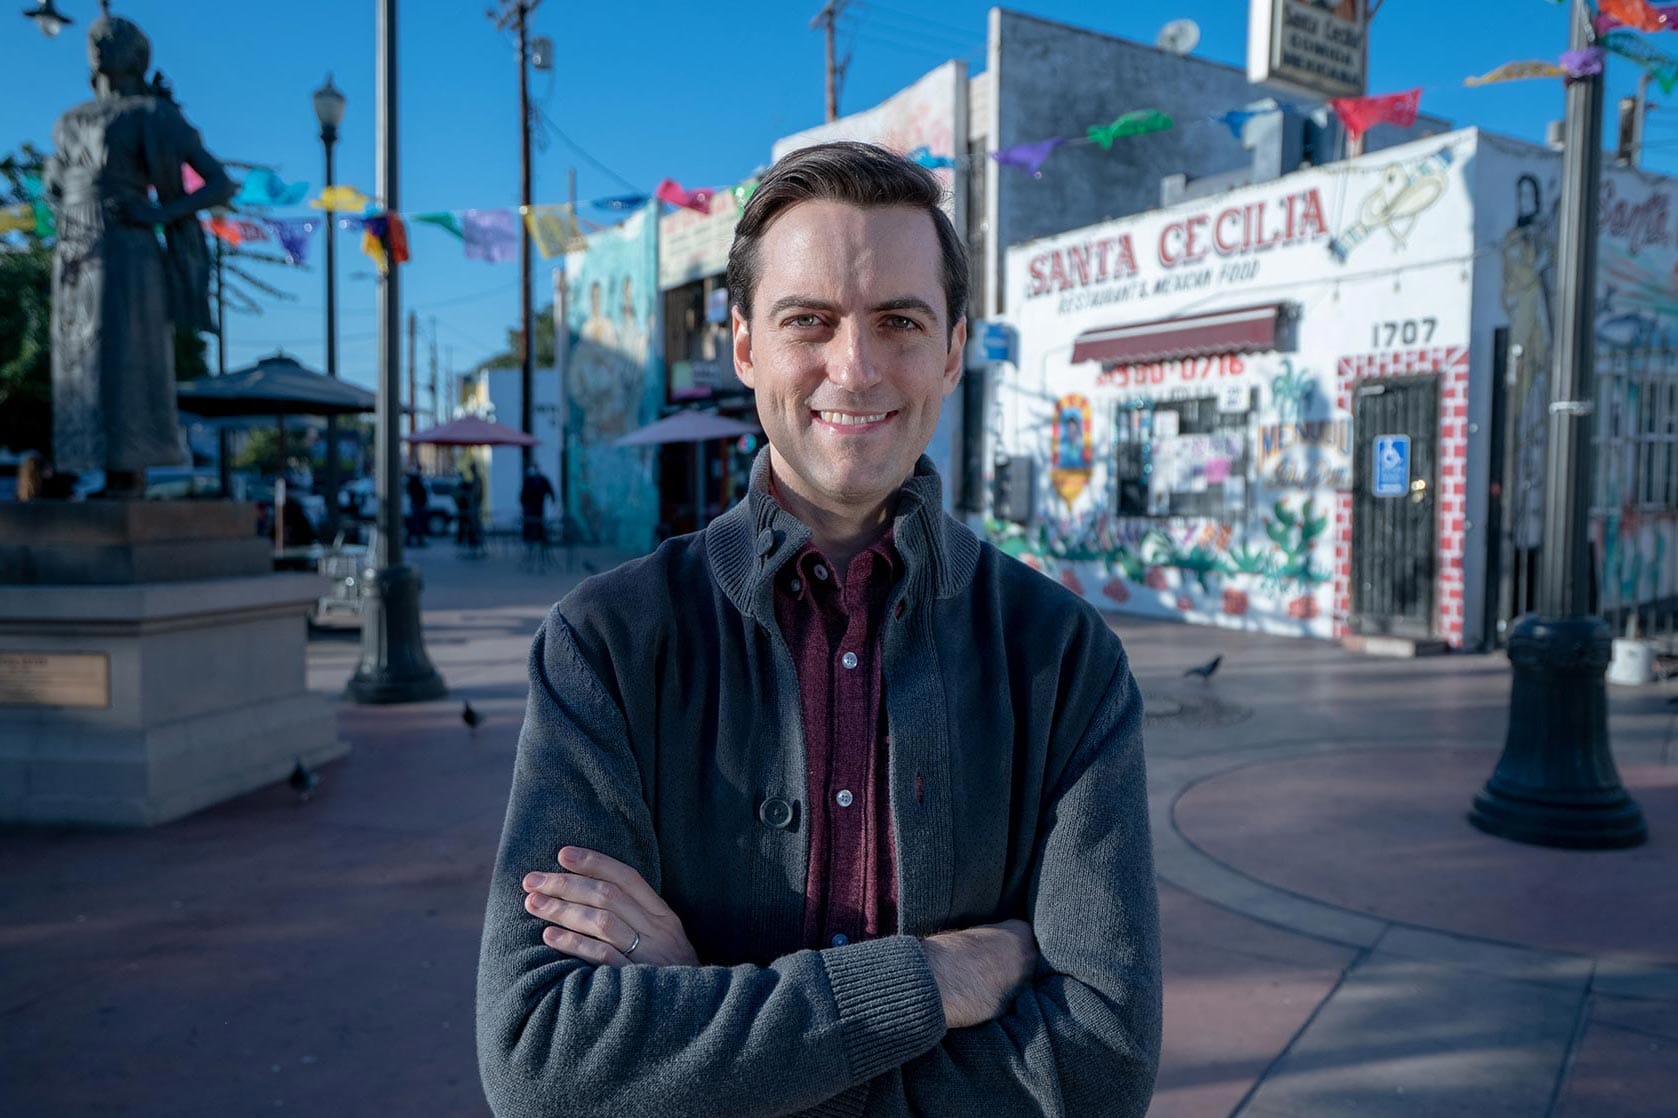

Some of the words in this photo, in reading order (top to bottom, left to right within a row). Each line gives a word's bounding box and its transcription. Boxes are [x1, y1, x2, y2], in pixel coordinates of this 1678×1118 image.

[1027, 233, 1138, 298] SANTA
[1158, 187, 1329, 268] CECILIA
[1058, 284, 1137, 315] RESTAURANT
[1152, 270, 1213, 295] MEXICAN
[1218, 258, 1262, 284] FOOD
[1372, 317, 1439, 348] 1707
